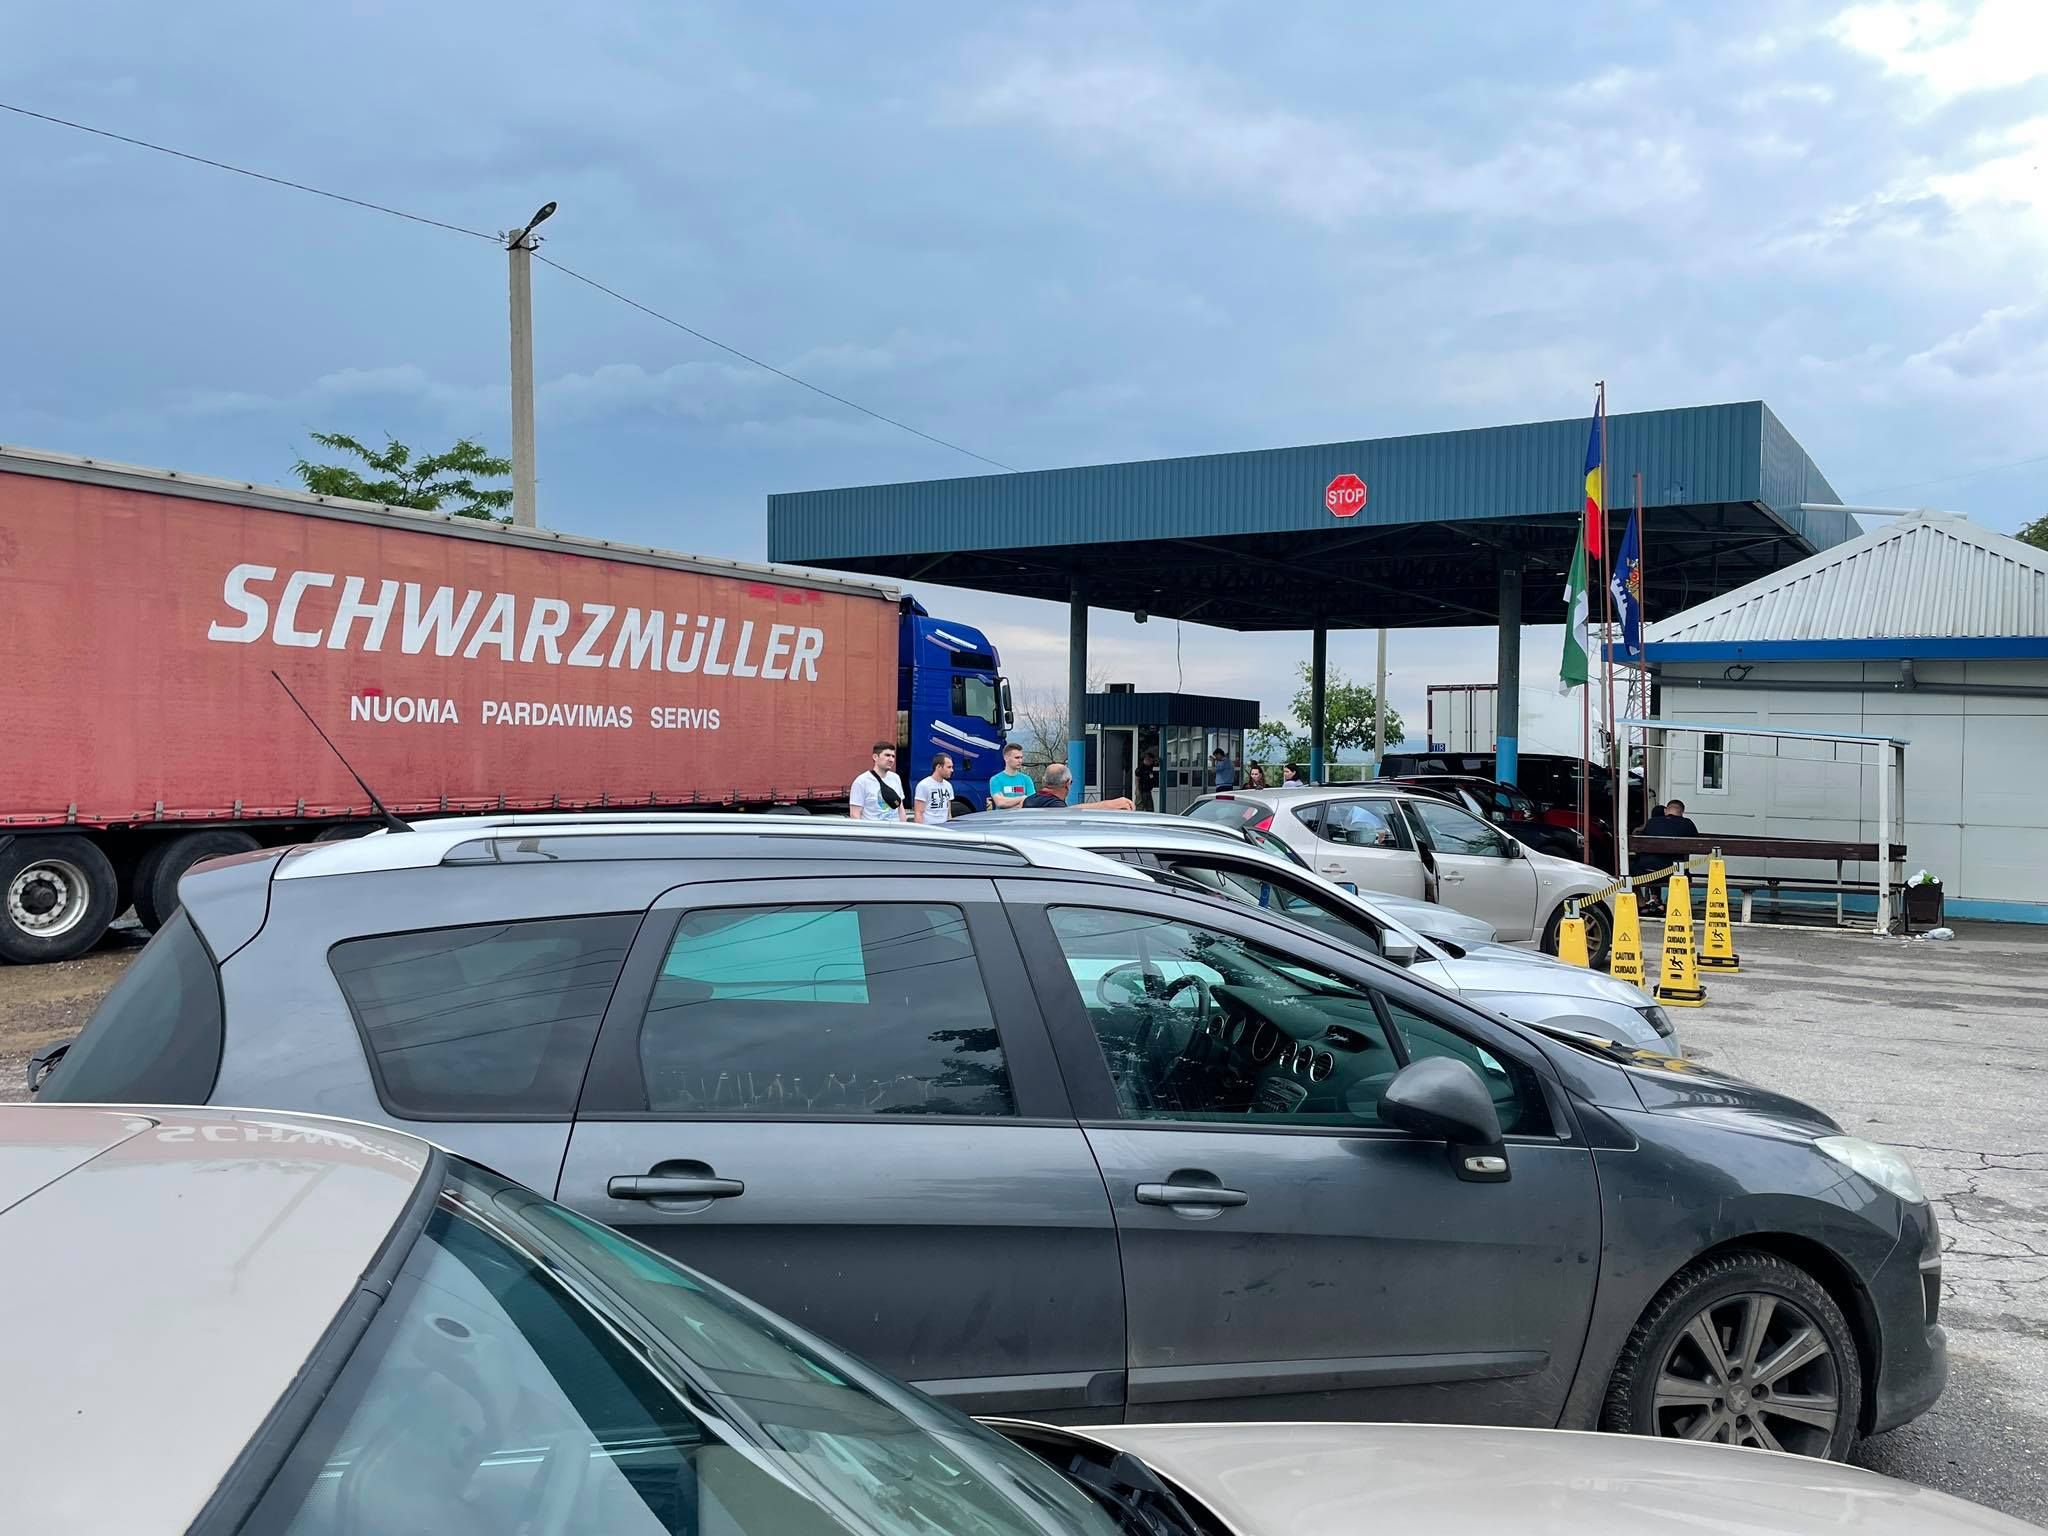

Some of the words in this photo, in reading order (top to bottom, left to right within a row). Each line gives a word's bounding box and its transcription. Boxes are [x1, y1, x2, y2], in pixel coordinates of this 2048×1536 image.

[1328, 488, 1364, 505] STOP
[207, 563, 824, 681] SCHWARZMÜLLER
[350, 696, 459, 724] NUOMA
[481, 701, 633, 729] PARDAVIMAS
[650, 706, 720, 730] SERVIS
[1433, 743, 1445, 752] TIR
[1667, 936, 1687, 944] CUIDADO
[1665, 947, 1688, 955] ATTENTION
[1615, 952, 1636, 961] CAUTION
[1614, 965, 1637, 975] CUIDADO
